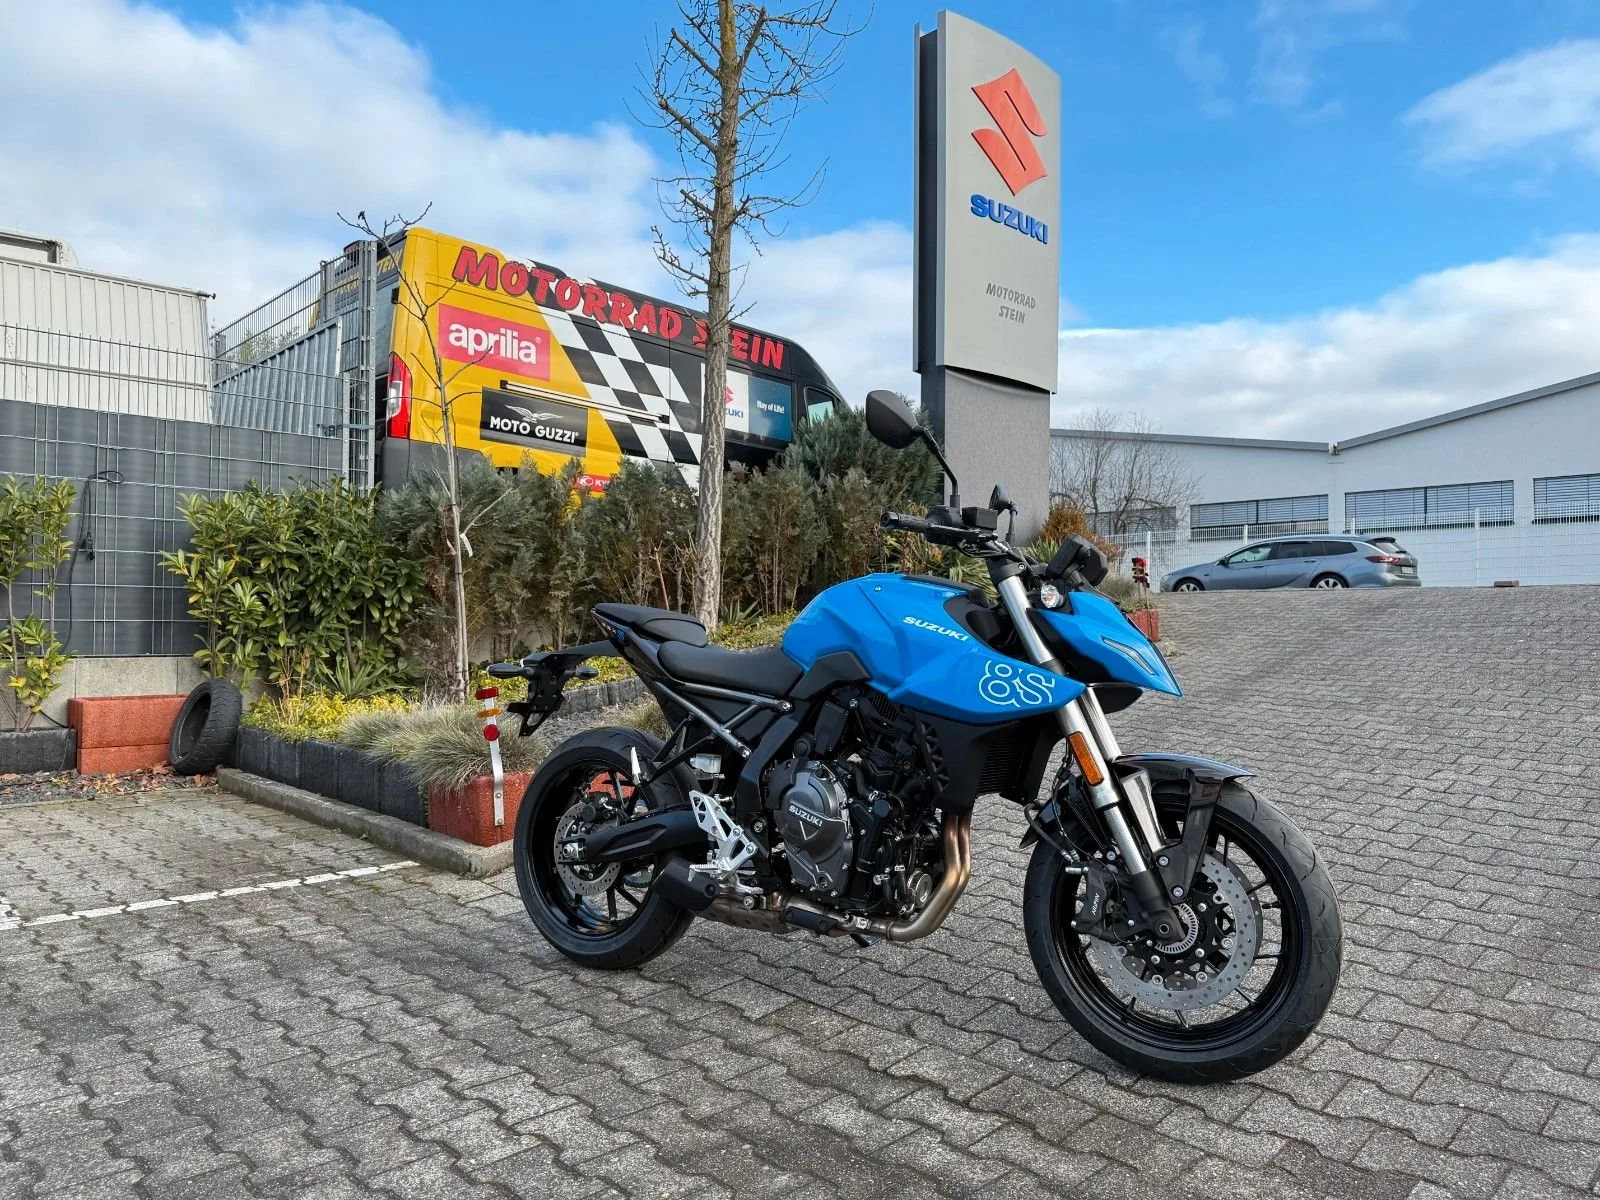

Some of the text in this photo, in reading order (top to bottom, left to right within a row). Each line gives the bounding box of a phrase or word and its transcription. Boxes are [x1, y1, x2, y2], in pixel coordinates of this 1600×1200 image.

[970, 194, 1048, 244] SUZUKI
[452, 246, 784, 370] MOTORRAD SEIN
[986, 283, 1036, 309] MOTORRAD
[999, 305, 1025, 324] STEIN
[757, 400, 767, 411] Way
[767, 403, 774, 411] of
[489, 415, 575, 443] MOTO GUZZI
[903, 616, 969, 642] SUZUKI
[788, 805, 823, 828] SUZUKI
